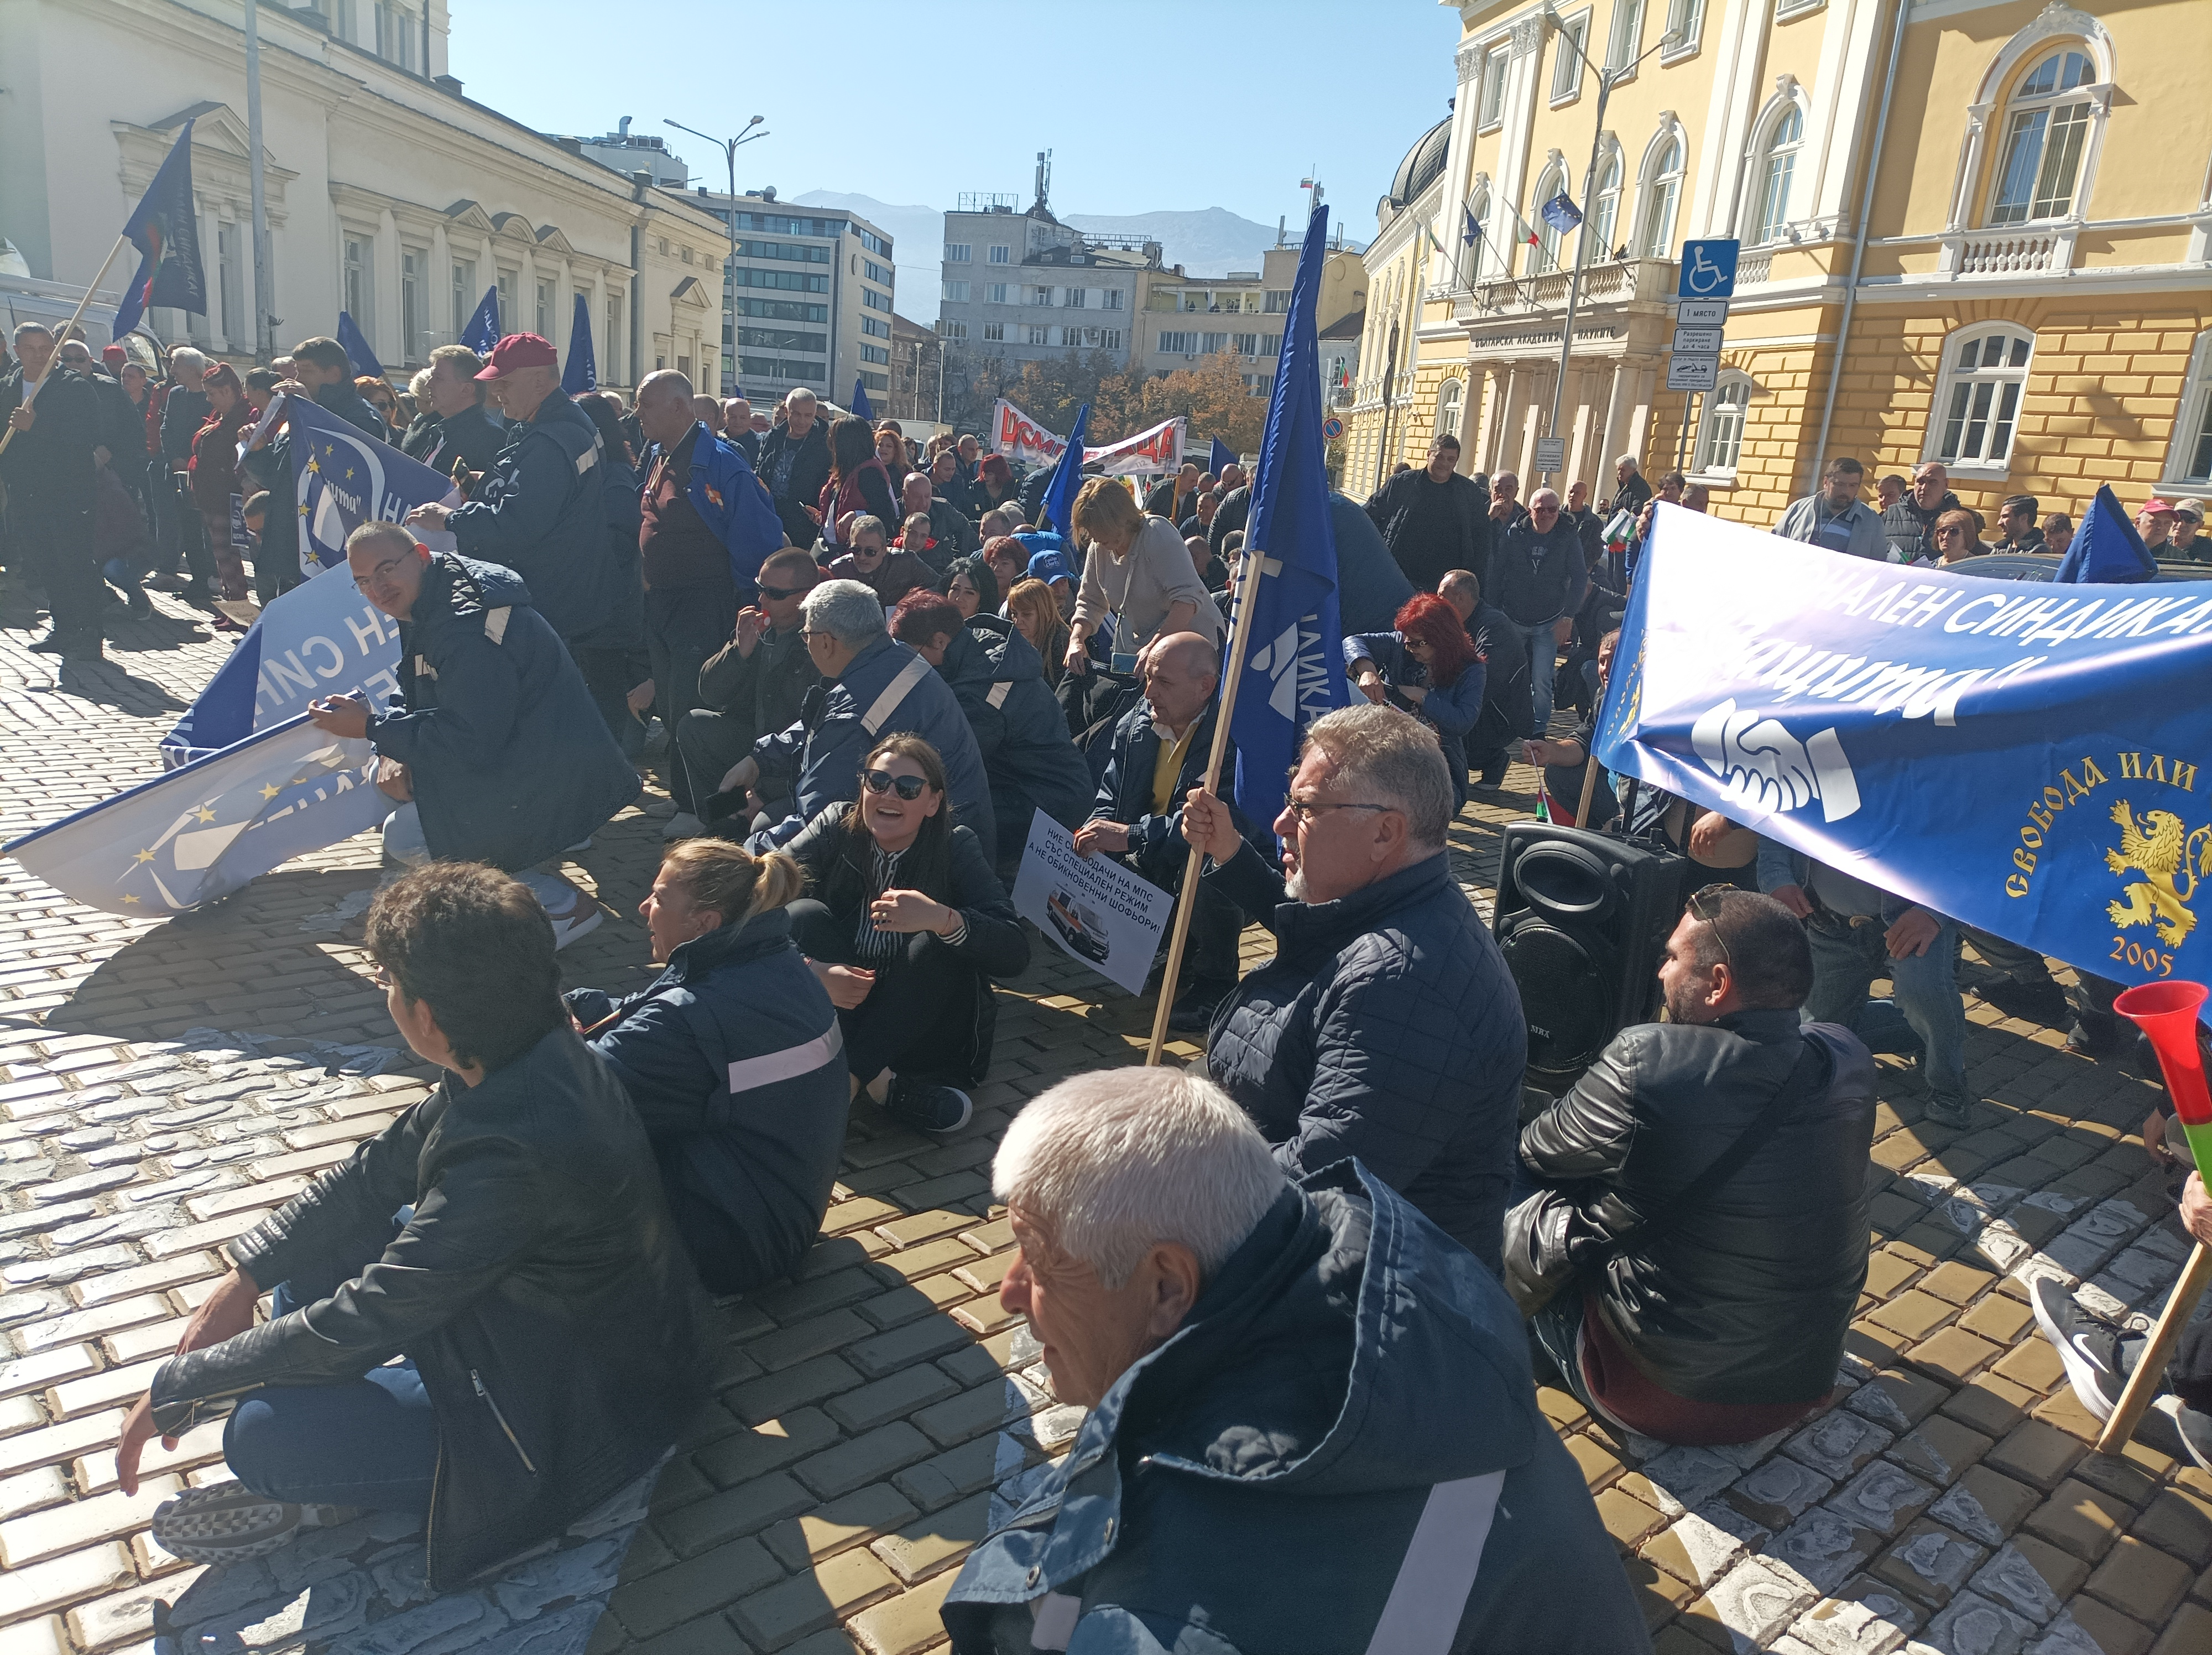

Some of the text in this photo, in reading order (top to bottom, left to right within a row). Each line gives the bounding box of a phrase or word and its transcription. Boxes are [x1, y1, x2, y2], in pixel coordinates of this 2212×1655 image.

[2005, 752, 2199, 898] СВОБОДА ИЛИ
[1029, 842, 1034, 850] А
[1035, 846, 1046, 860] НЕ
[1047, 856, 1108, 903] ОБИКНОВЕННИ
[1109, 898, 1161, 934] ШОФЬОРИ!
[1045, 840, 1062, 857] СЪС
[1063, 852, 1113, 893] СПЕЦИАЛЕН
[1114, 886, 1149, 913] РЕЖИМ
[1047, 828, 1063, 845] НИЕ
[1118, 876, 1130, 889] НА
[1133, 884, 1154, 903] МПС
[2109, 935, 2175, 977] 2005
